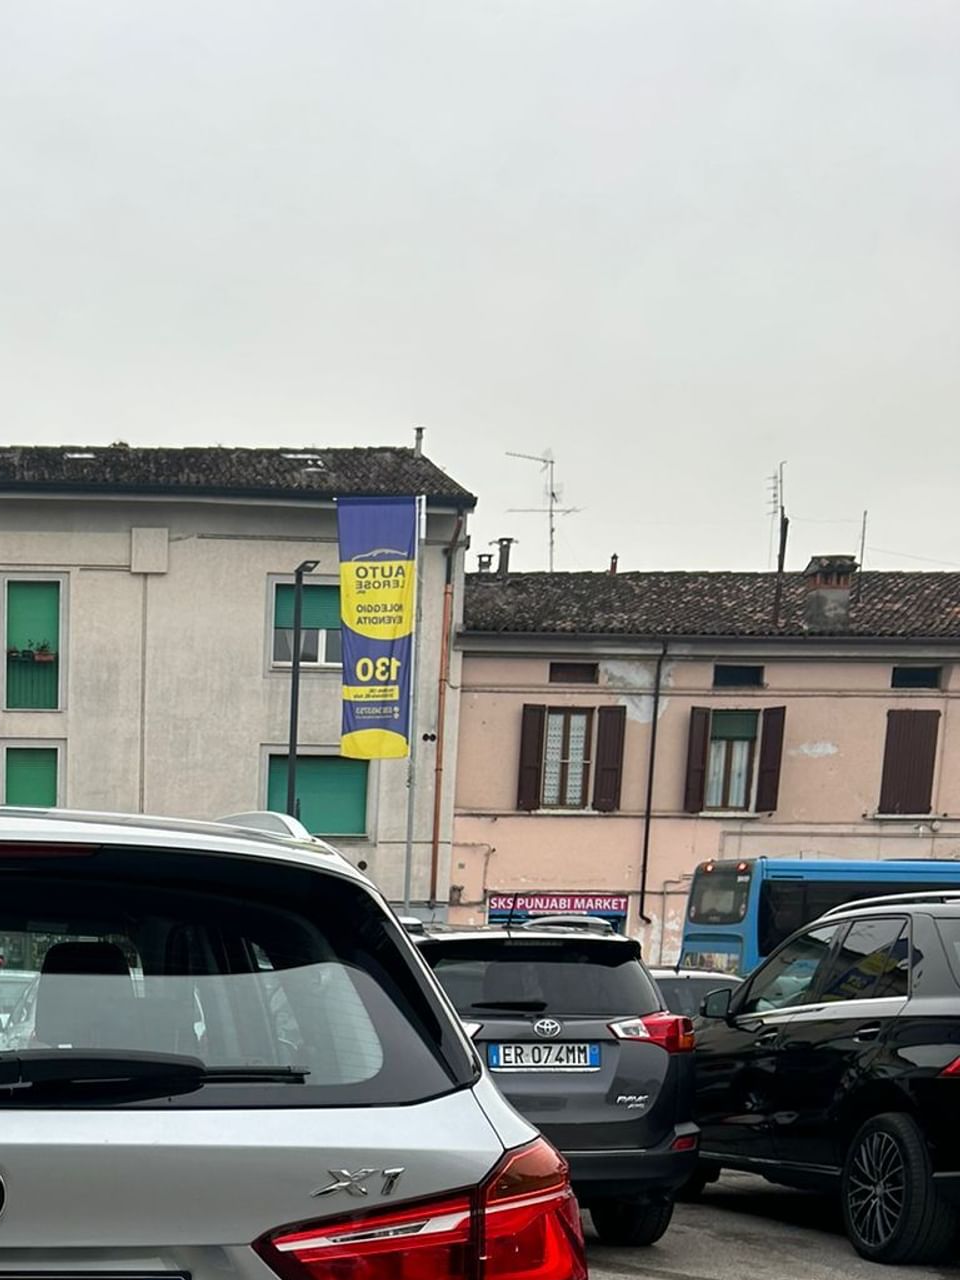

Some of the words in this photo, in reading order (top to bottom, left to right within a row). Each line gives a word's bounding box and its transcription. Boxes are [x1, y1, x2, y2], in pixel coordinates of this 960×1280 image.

[490, 897, 514, 910] SKS
[517, 897, 571, 910] PUNJABI
[573, 897, 627, 910] MARKET
[502, 1045, 524, 1065] ER
[531, 1045, 589, 1065] 074MM
[310, 1167, 405, 1198] X1
